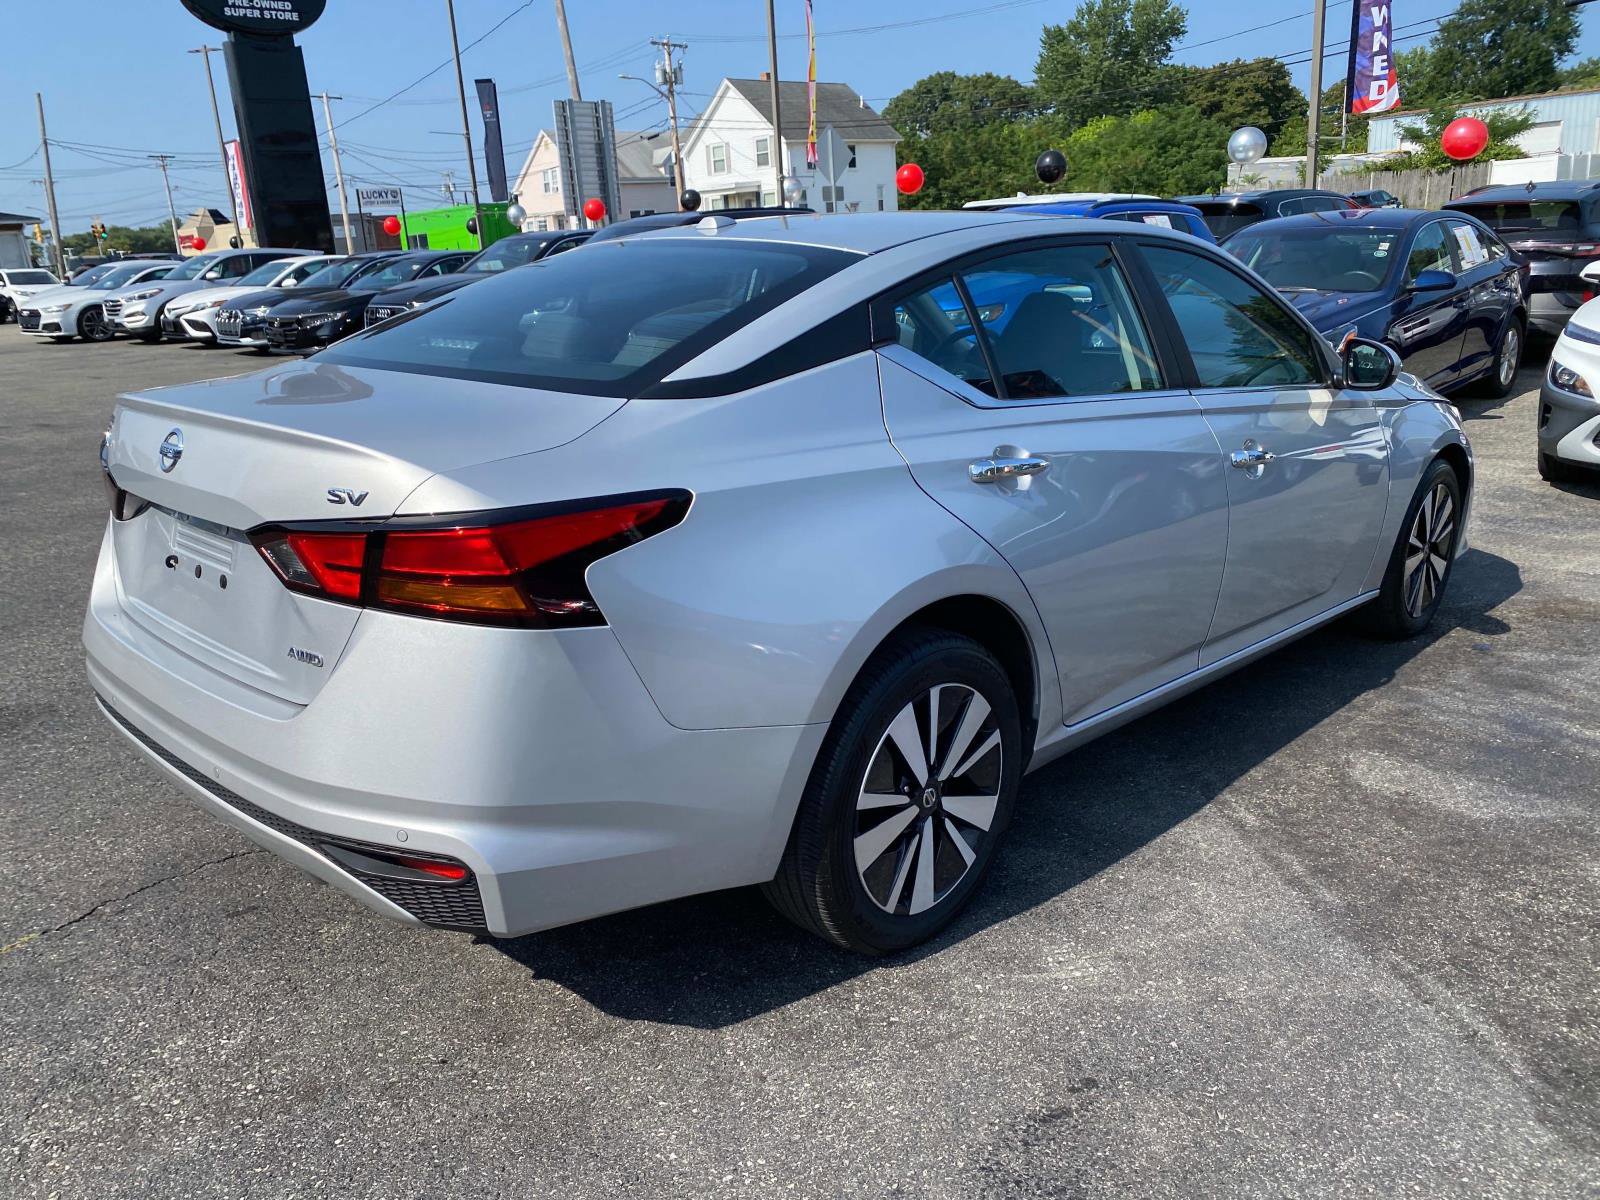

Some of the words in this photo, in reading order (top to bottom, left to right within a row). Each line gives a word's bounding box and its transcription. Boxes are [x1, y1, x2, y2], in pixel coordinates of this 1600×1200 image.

[227, 0, 292, 10] PRE-OWNED
[224, 7, 261, 18] SUPER
[263, 10, 300, 21] STORE
[361, 190, 389, 200] LUCKY
[326, 488, 370, 507] SV
[287, 647, 324, 668] AWD
